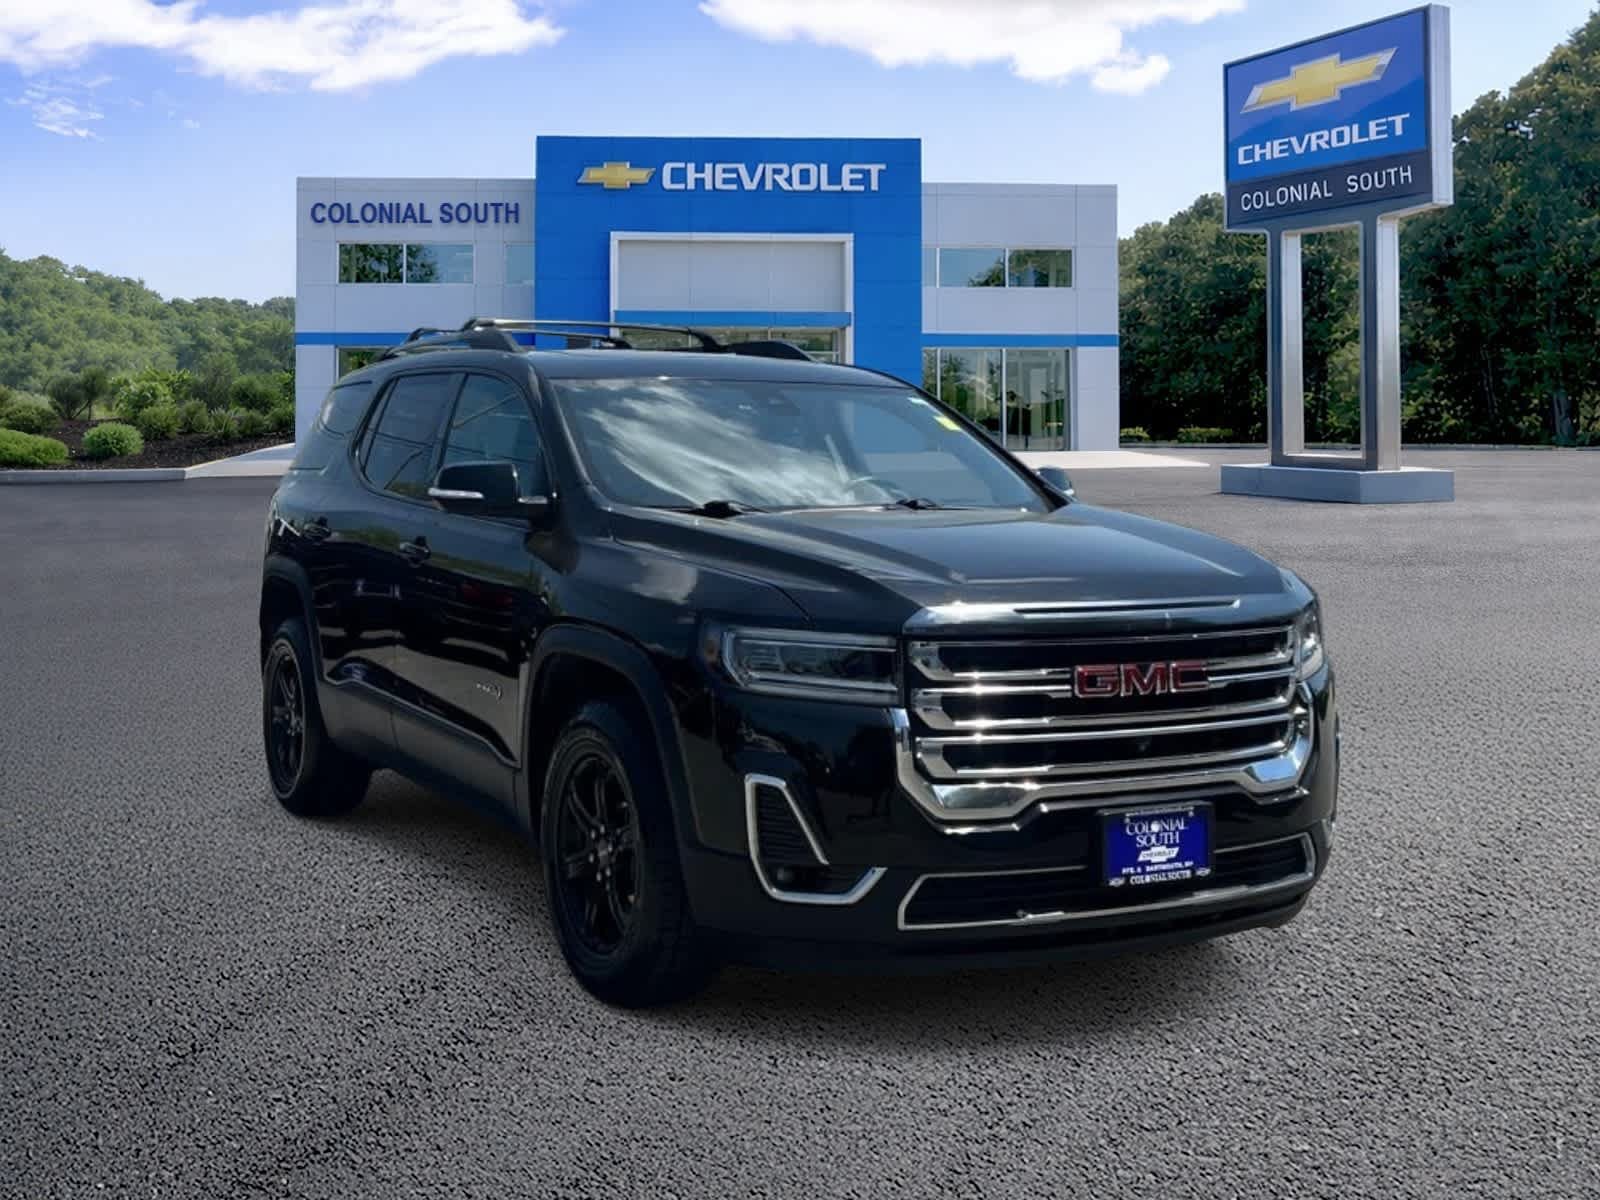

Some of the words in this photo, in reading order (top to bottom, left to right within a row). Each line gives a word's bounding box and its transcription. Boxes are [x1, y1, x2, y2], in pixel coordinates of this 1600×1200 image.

[1237, 113, 1410, 166] CHEVROLET
[661, 161, 887, 192] CHEVROLET
[1240, 180, 1333, 212] COLONIAL
[1346, 165, 1413, 194] SOUTH
[310, 202, 433, 225] COLONIAL
[438, 202, 521, 225] SOUTH
[1074, 660, 1209, 699] GMC
[1125, 817, 1188, 836] COLONIAL
[1135, 831, 1180, 848] SOUTH
